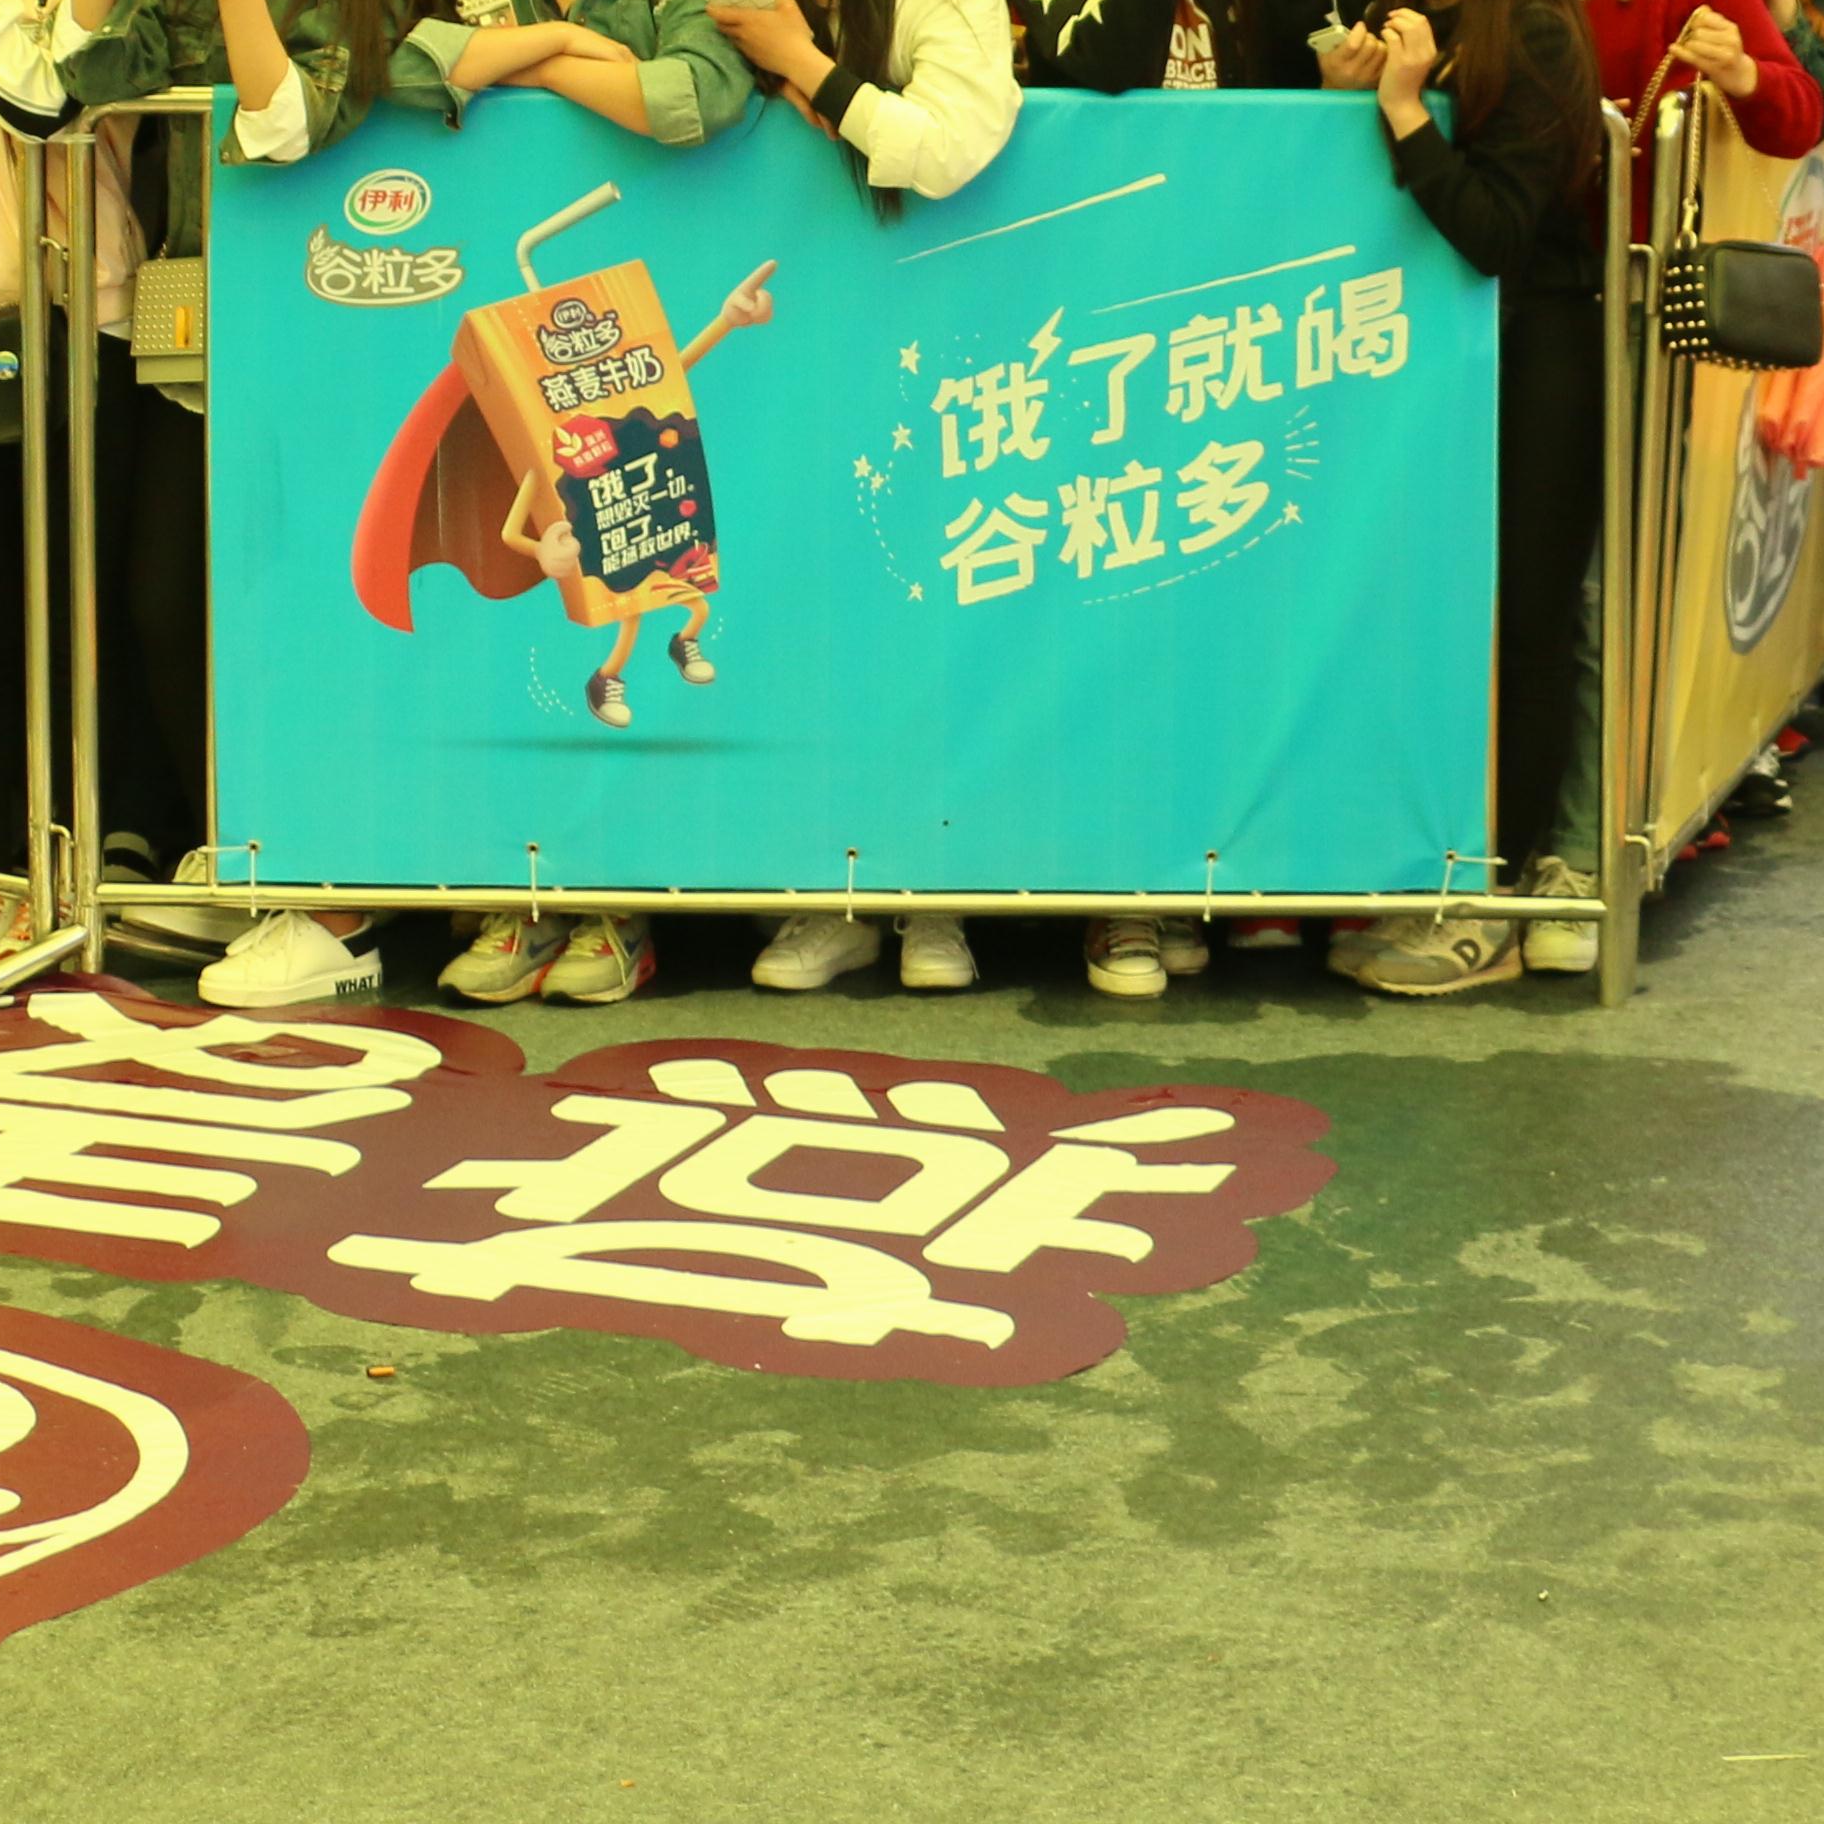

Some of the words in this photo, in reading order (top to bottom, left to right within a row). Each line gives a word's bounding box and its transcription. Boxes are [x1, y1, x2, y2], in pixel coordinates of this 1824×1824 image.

[359, 189, 416, 212] 伊利
[314, 248, 463, 295] 谷粒多
[550, 319, 619, 360] 谷粒多
[541, 348, 661, 410] 燕麦牛奶
[930, 267, 1409, 479] 饿了就喝
[940, 440, 1270, 606] 谷粒多
